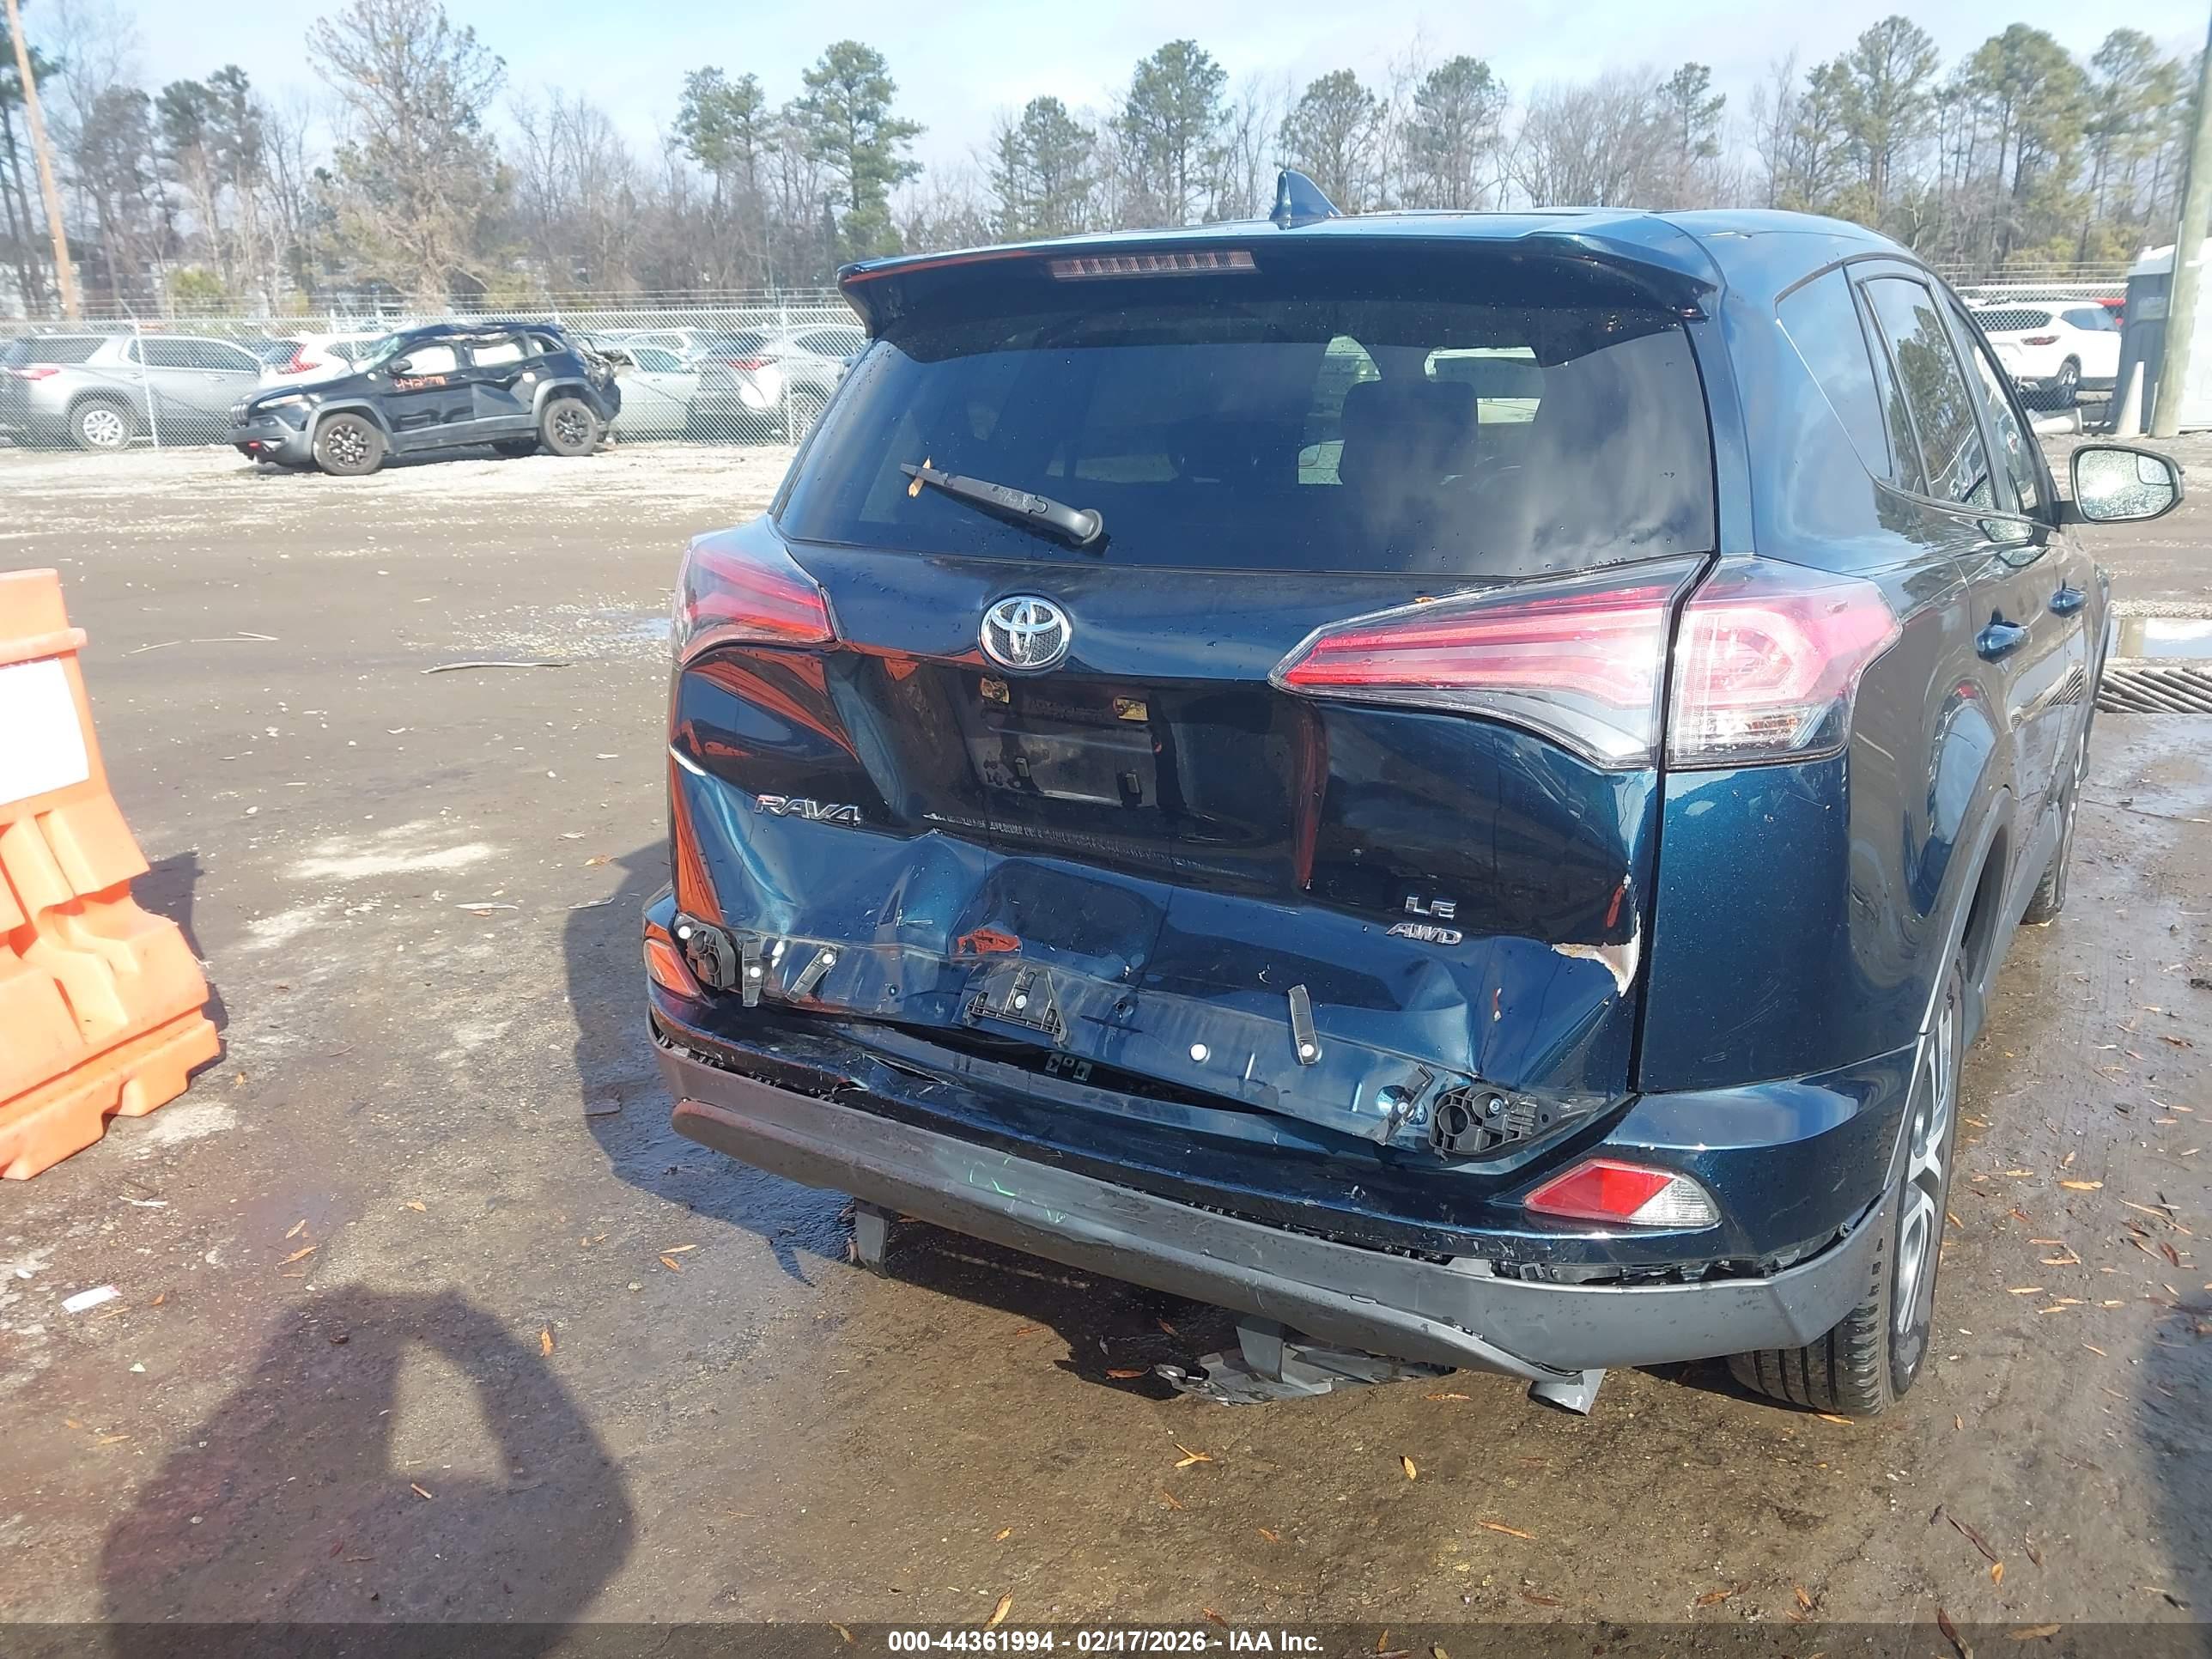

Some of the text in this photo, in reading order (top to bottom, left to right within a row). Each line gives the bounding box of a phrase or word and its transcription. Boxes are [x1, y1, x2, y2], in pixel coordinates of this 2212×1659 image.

[754, 793, 861, 826] RAV4
[1405, 896, 1456, 920] LE
[1385, 922, 1463, 945] AWD
